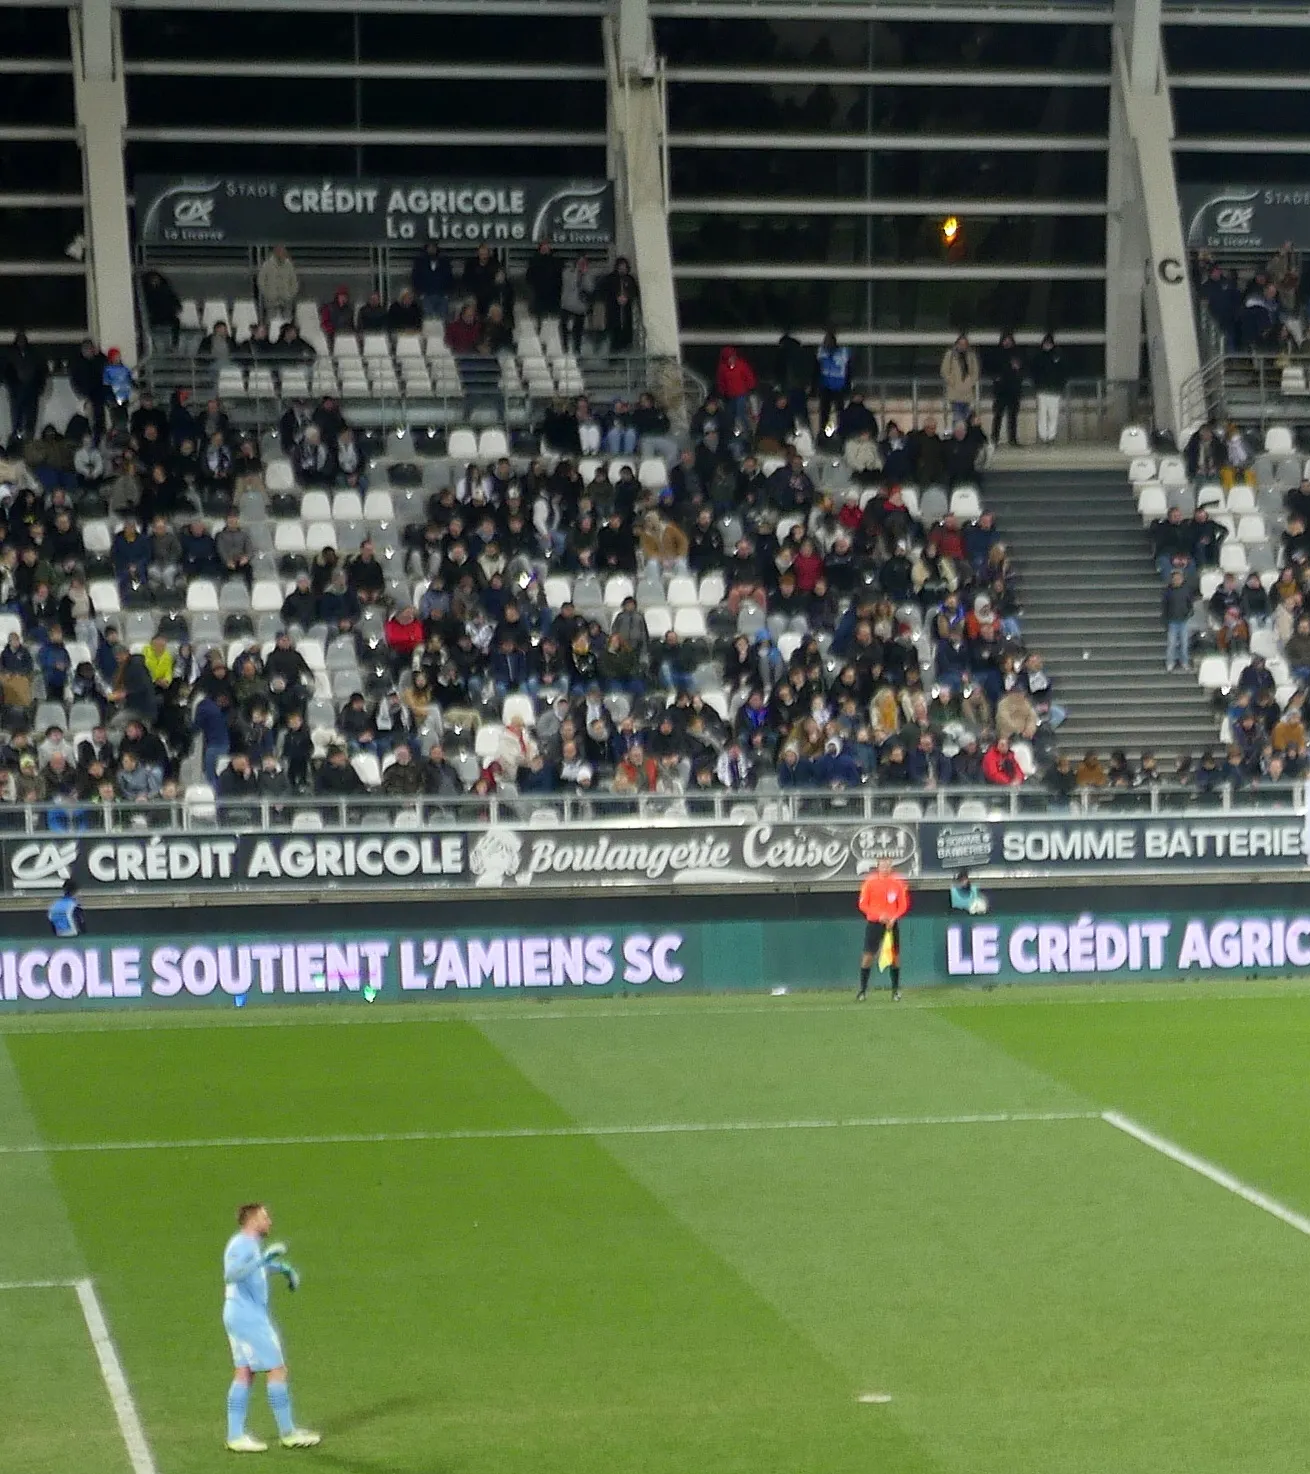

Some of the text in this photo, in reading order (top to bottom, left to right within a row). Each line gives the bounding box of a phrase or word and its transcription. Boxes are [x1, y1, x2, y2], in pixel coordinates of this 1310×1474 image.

[283, 184, 378, 213] CRÉDIT
[388, 190, 524, 215] AGRICOLE
[387, 217, 526, 240] La Licorne
[1158, 258, 1184, 285] C
[88, 836, 463, 881] CRÉDIT AGRICOLE
[530, 824, 849, 881] Boulangerie Cerise
[1003, 825, 1307, 862] SOMME BATTERIE
[947, 922, 1000, 976] LE
[1009, 912, 1170, 975] CRÉDIT
[0, 933, 684, 1000] ICOLE SOUTIENT L'AMIENS SC
